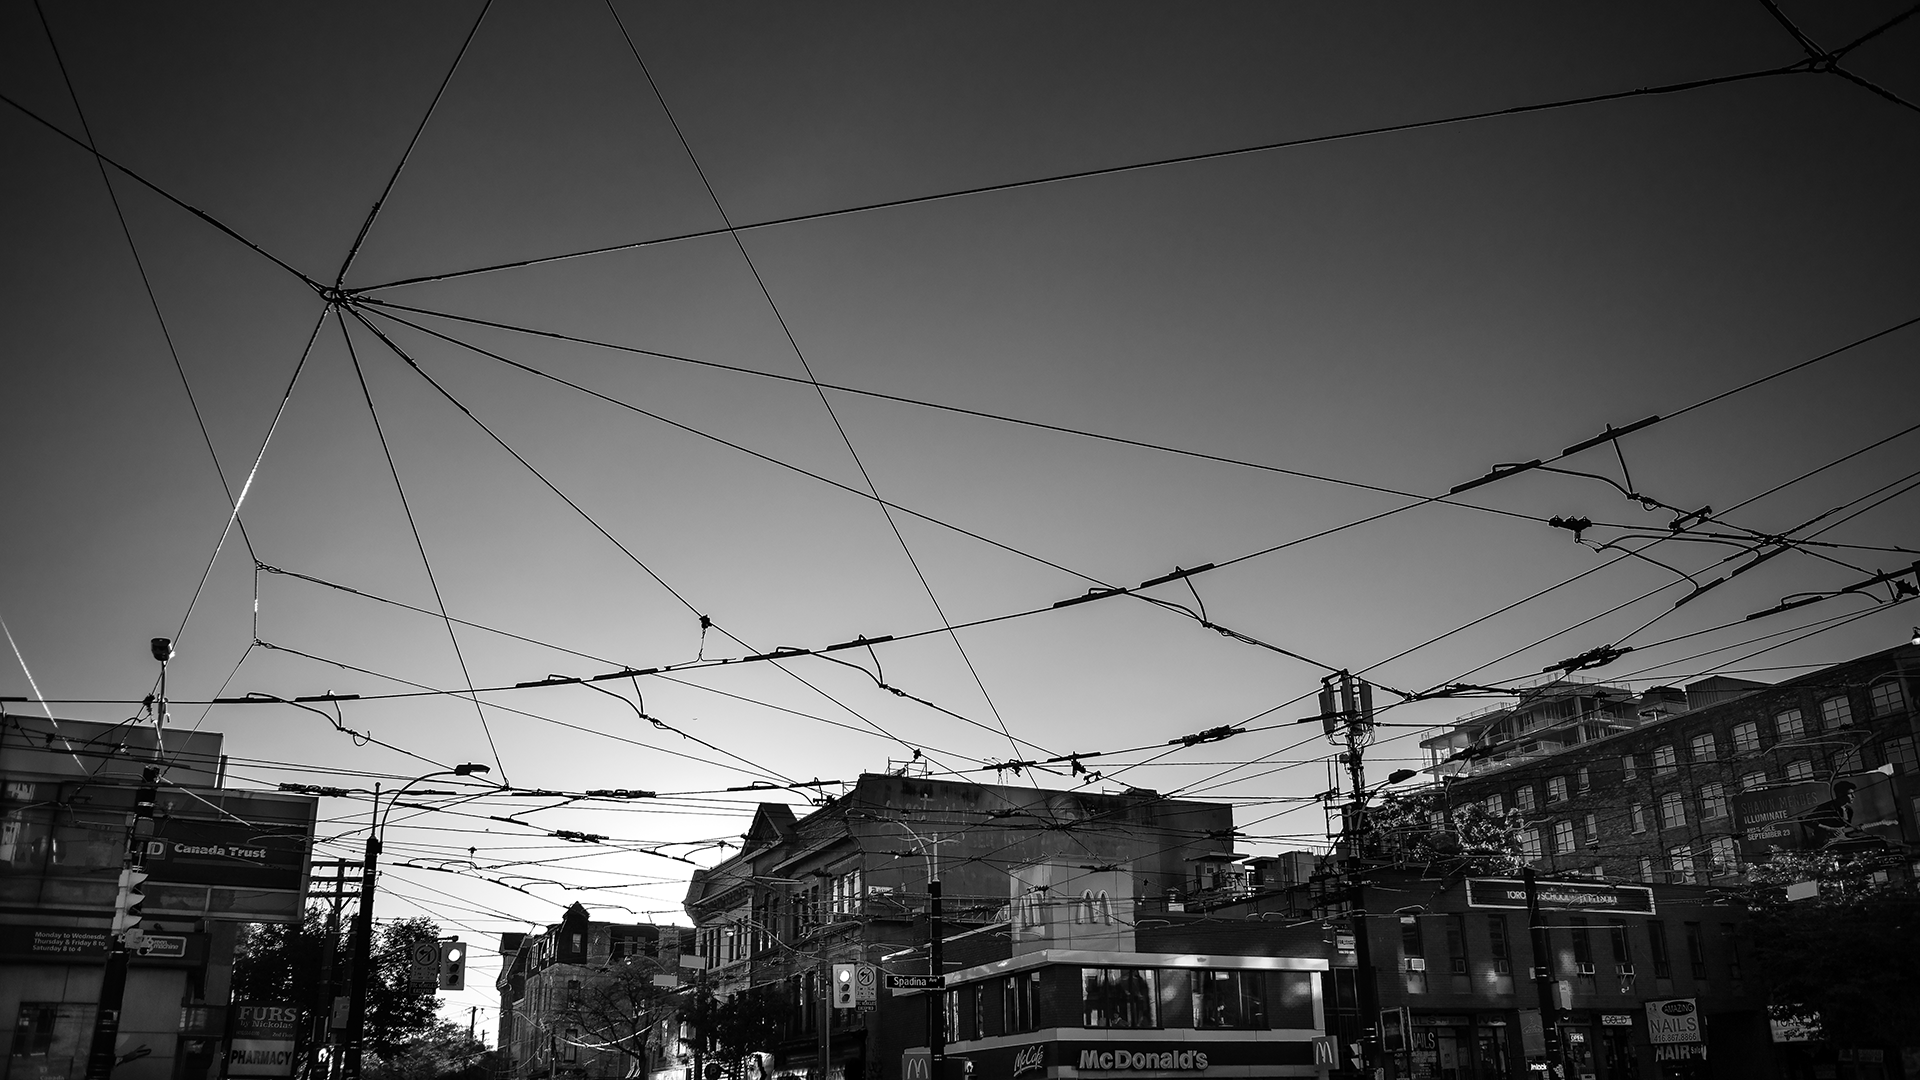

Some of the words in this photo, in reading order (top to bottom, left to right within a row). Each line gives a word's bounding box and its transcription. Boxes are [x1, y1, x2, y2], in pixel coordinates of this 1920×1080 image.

[1741, 800, 1775, 815] SHAWN
[1778, 793, 1818, 810] MENDES
[1744, 811, 1788, 824] ILLUMINATE
[1747, 830, 1782, 841] SEPTEMBER
[174, 843, 225, 856] Canada
[229, 846, 267, 859] Trust
[34, 931, 61, 941] Monday
[72, 932, 106, 940] Wednesda
[32, 945, 60, 953] Saturday
[33, 938, 65, 948] Thursday
[73, 939, 92, 947] Friday
[894, 976, 927, 988] Spadina
[238, 1006, 297, 1022] FURS
[1664, 1004, 1693, 1013] AMAZING
[252, 1021, 293, 1029] Nickolas
[1650, 1017, 1697, 1033] NAILS
[231, 1050, 292, 1065] PHARMACY
[1079, 1049, 1209, 1070] McDonald's
[1655, 1044, 1691, 1062] HAIR
